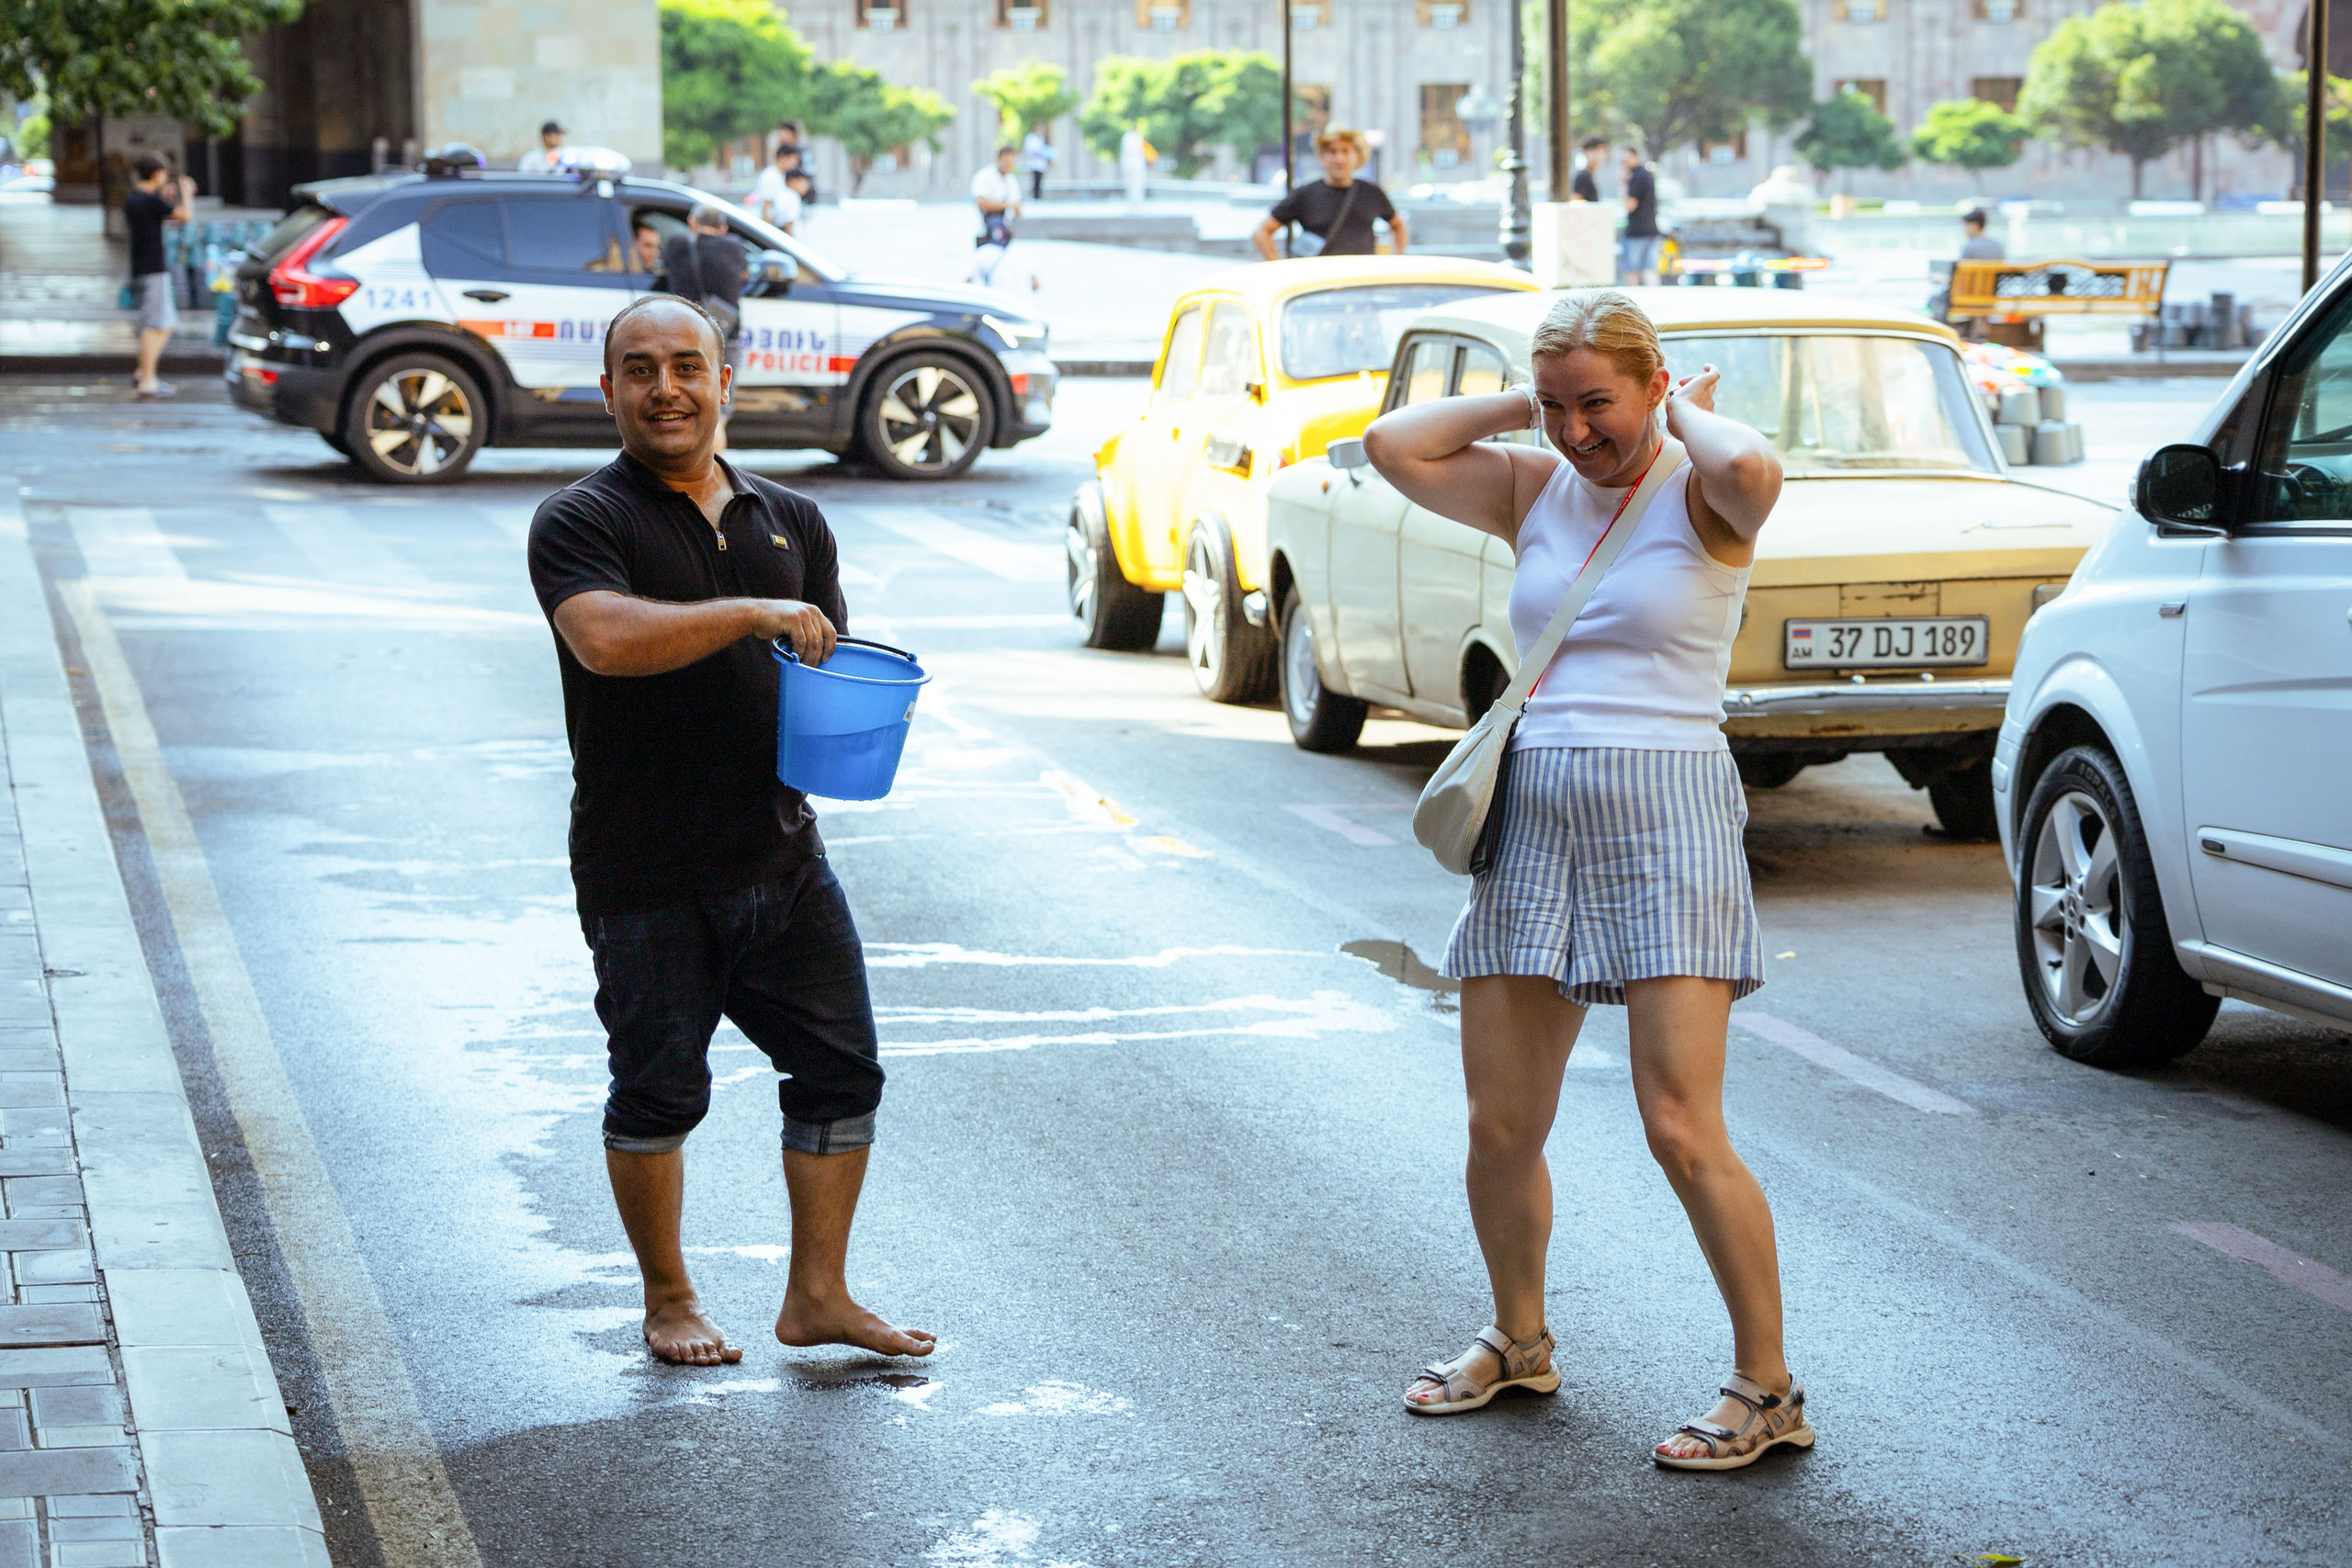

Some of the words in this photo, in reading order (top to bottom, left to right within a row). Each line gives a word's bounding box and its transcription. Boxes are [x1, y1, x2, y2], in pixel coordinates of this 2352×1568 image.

[366, 287, 431, 310] 1241
[1792, 648, 1813, 660] AM
[1827, 626, 1862, 659] 37
[1872, 626, 1914, 658] DJ
[1923, 626, 1975, 657] 189
